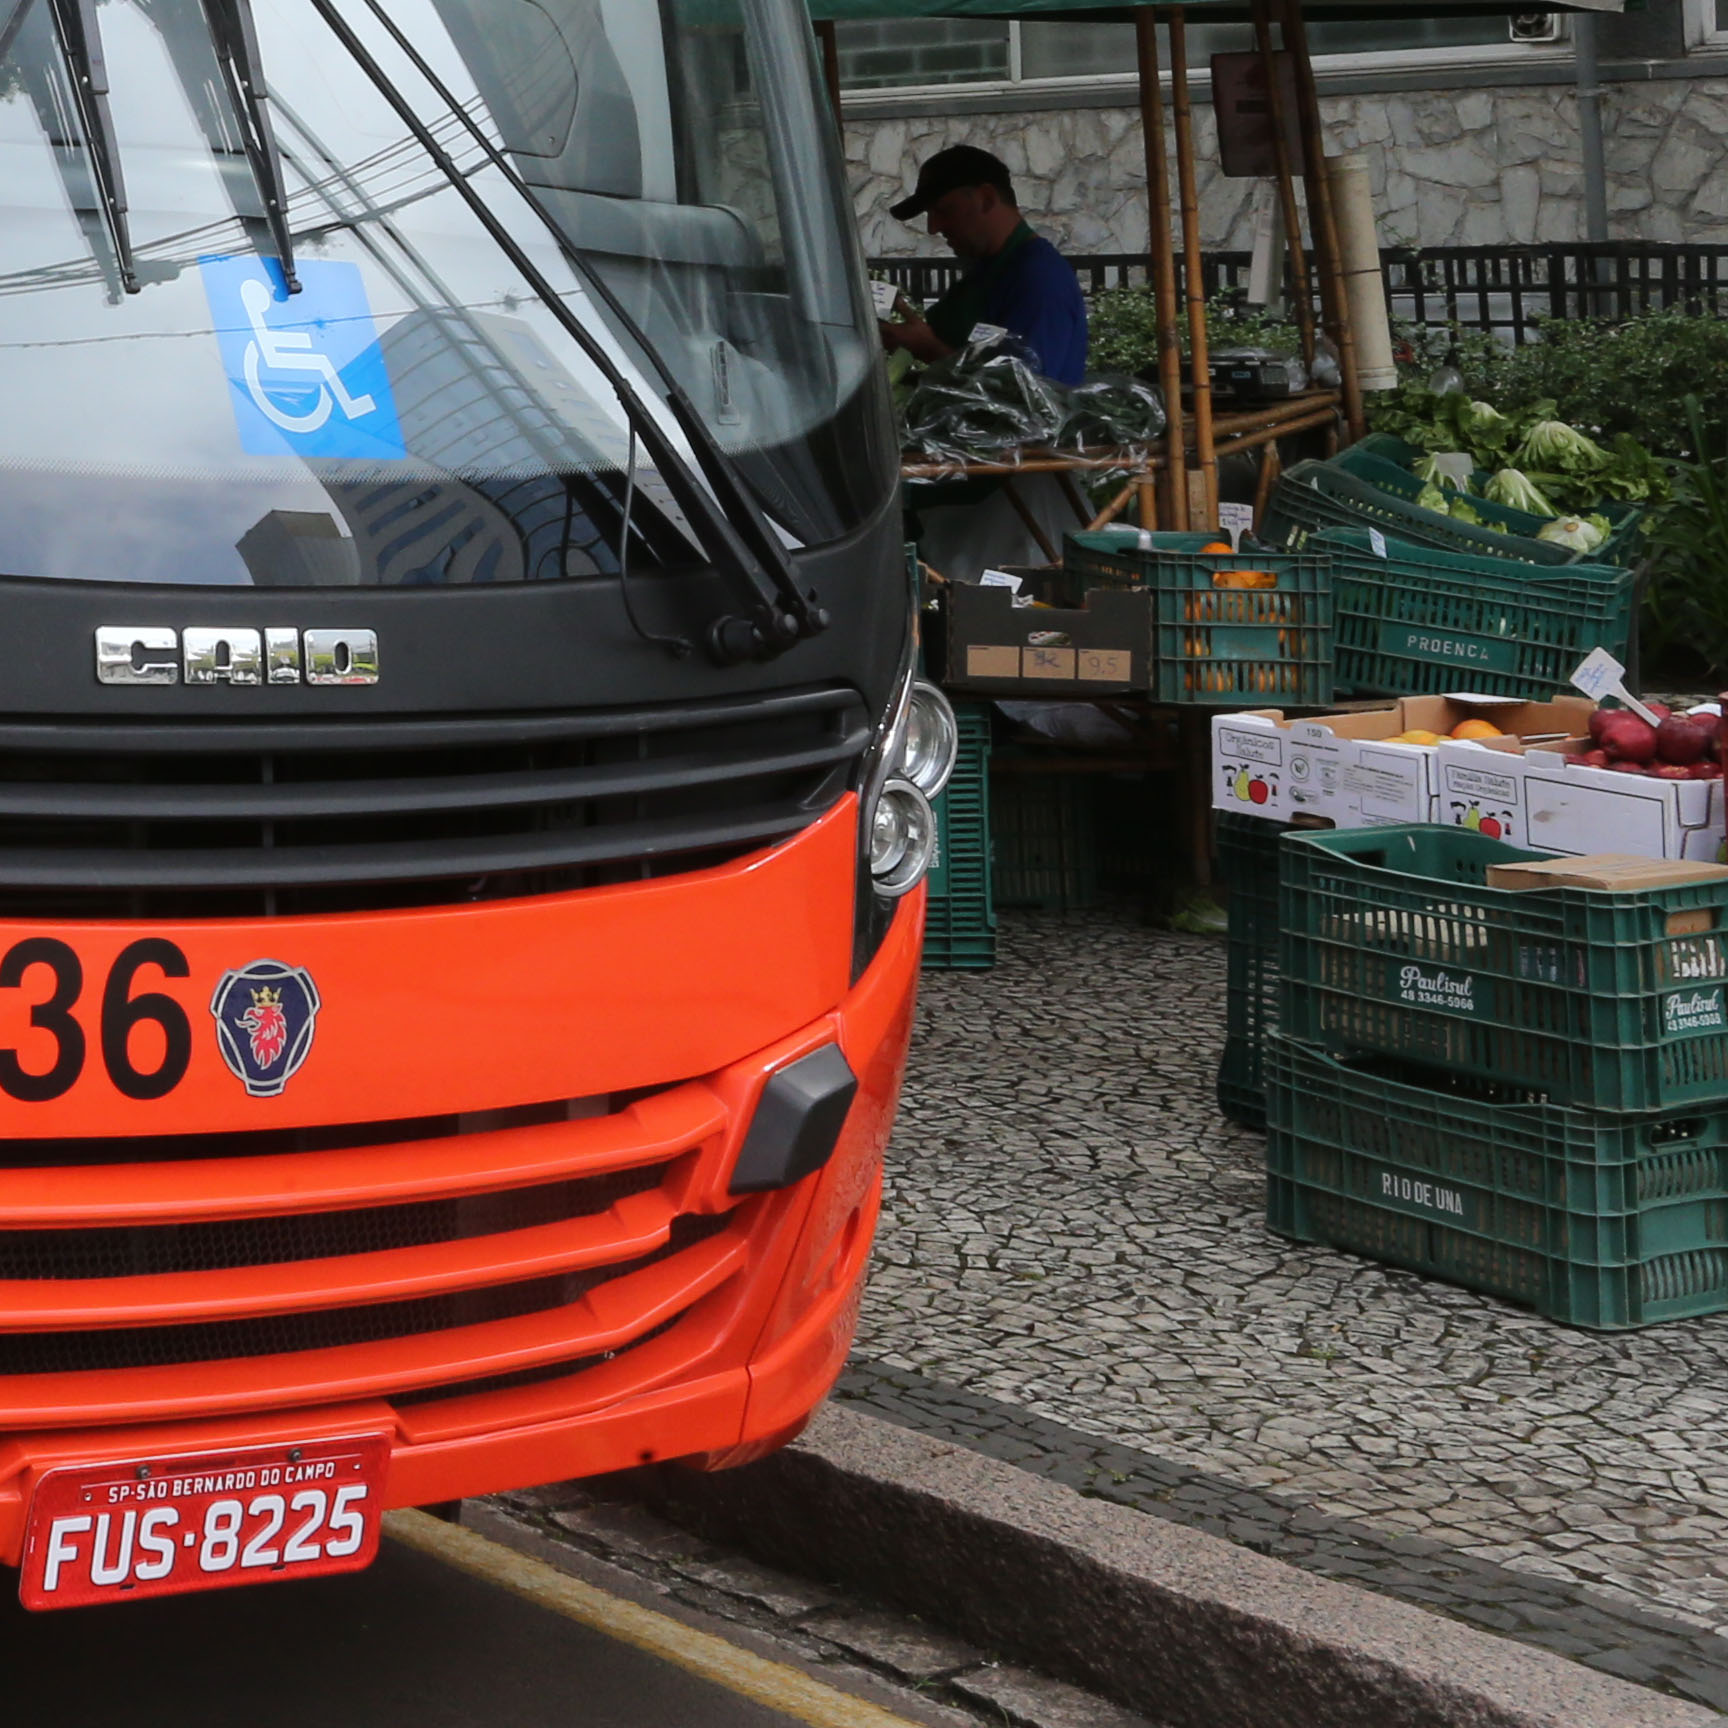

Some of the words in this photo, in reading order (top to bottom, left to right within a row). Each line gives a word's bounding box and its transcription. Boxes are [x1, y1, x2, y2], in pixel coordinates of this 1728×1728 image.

[95, 625, 380, 686] CAIO
[1400, 966, 1472, 996] Paulisul
[1382, 1173, 1411, 1200] RIO
[1414, 1181, 1433, 1207] DE
[1435, 1186, 1464, 1215] UNA
[172, 1471, 255, 1497] BERNARDO
[260, 1468, 280, 1486] DO
[285, 1462, 335, 1484] CAMPO
